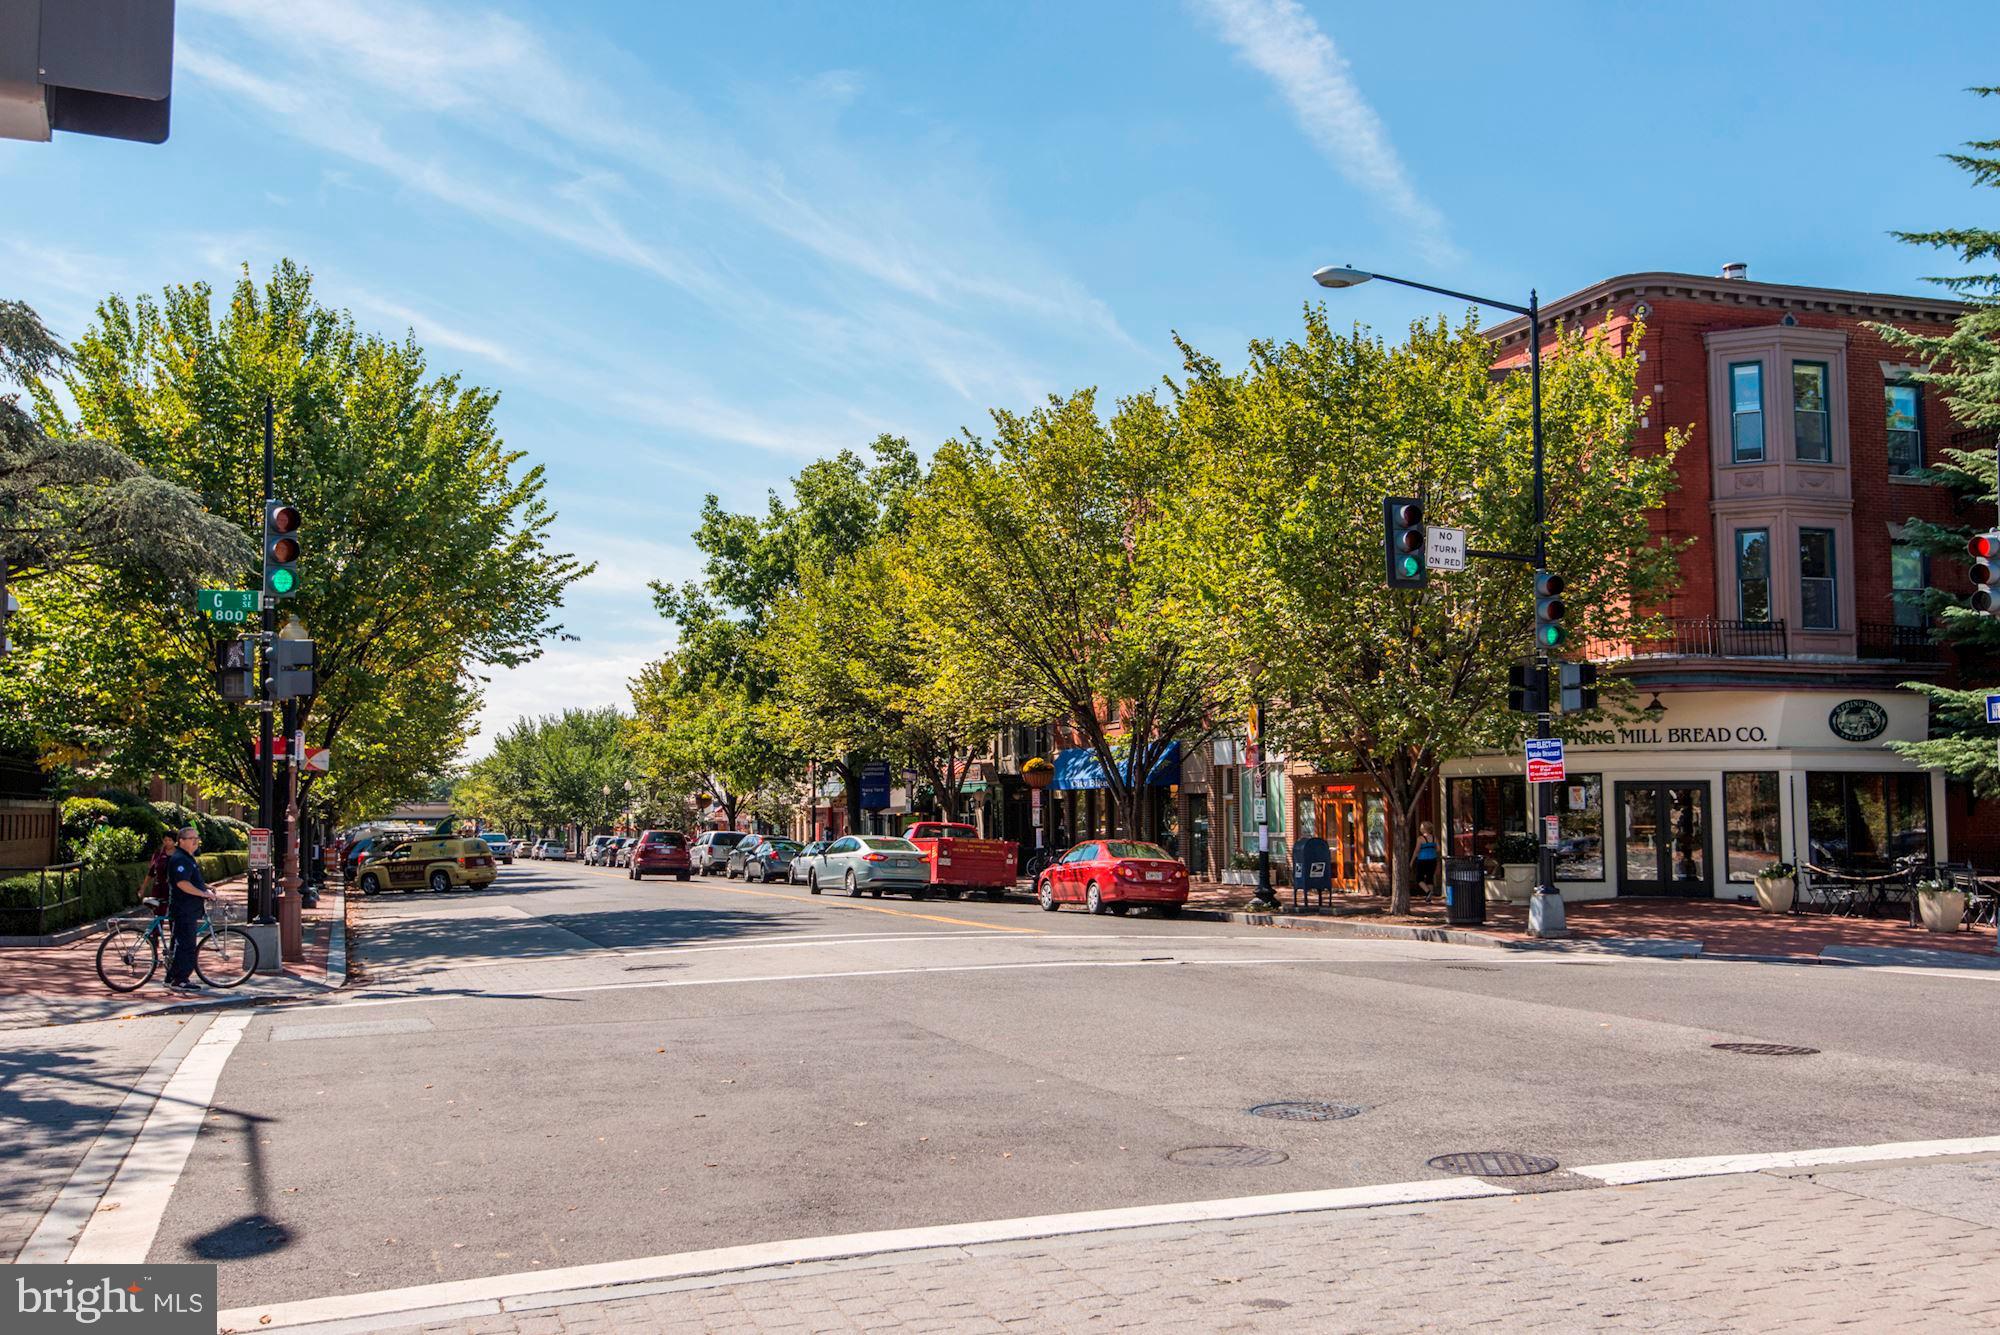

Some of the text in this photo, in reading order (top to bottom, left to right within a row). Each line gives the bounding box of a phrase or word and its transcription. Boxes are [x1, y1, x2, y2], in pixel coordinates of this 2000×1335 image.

[1439, 532, 1453, 540] NO
[1434, 544, 1457, 554] TURN
[1429, 556, 1461, 567] ON RED
[213, 592, 223, 608] G
[242, 593, 252, 601] ST
[215, 610, 244, 621] 800
[1621, 729, 1662, 744] MILL
[1668, 727, 1731, 743] BREAD
[1736, 726, 1767, 742] CO.
[1536, 740, 1551, 749] ELECT
[1071, 779, 1088, 789] City
